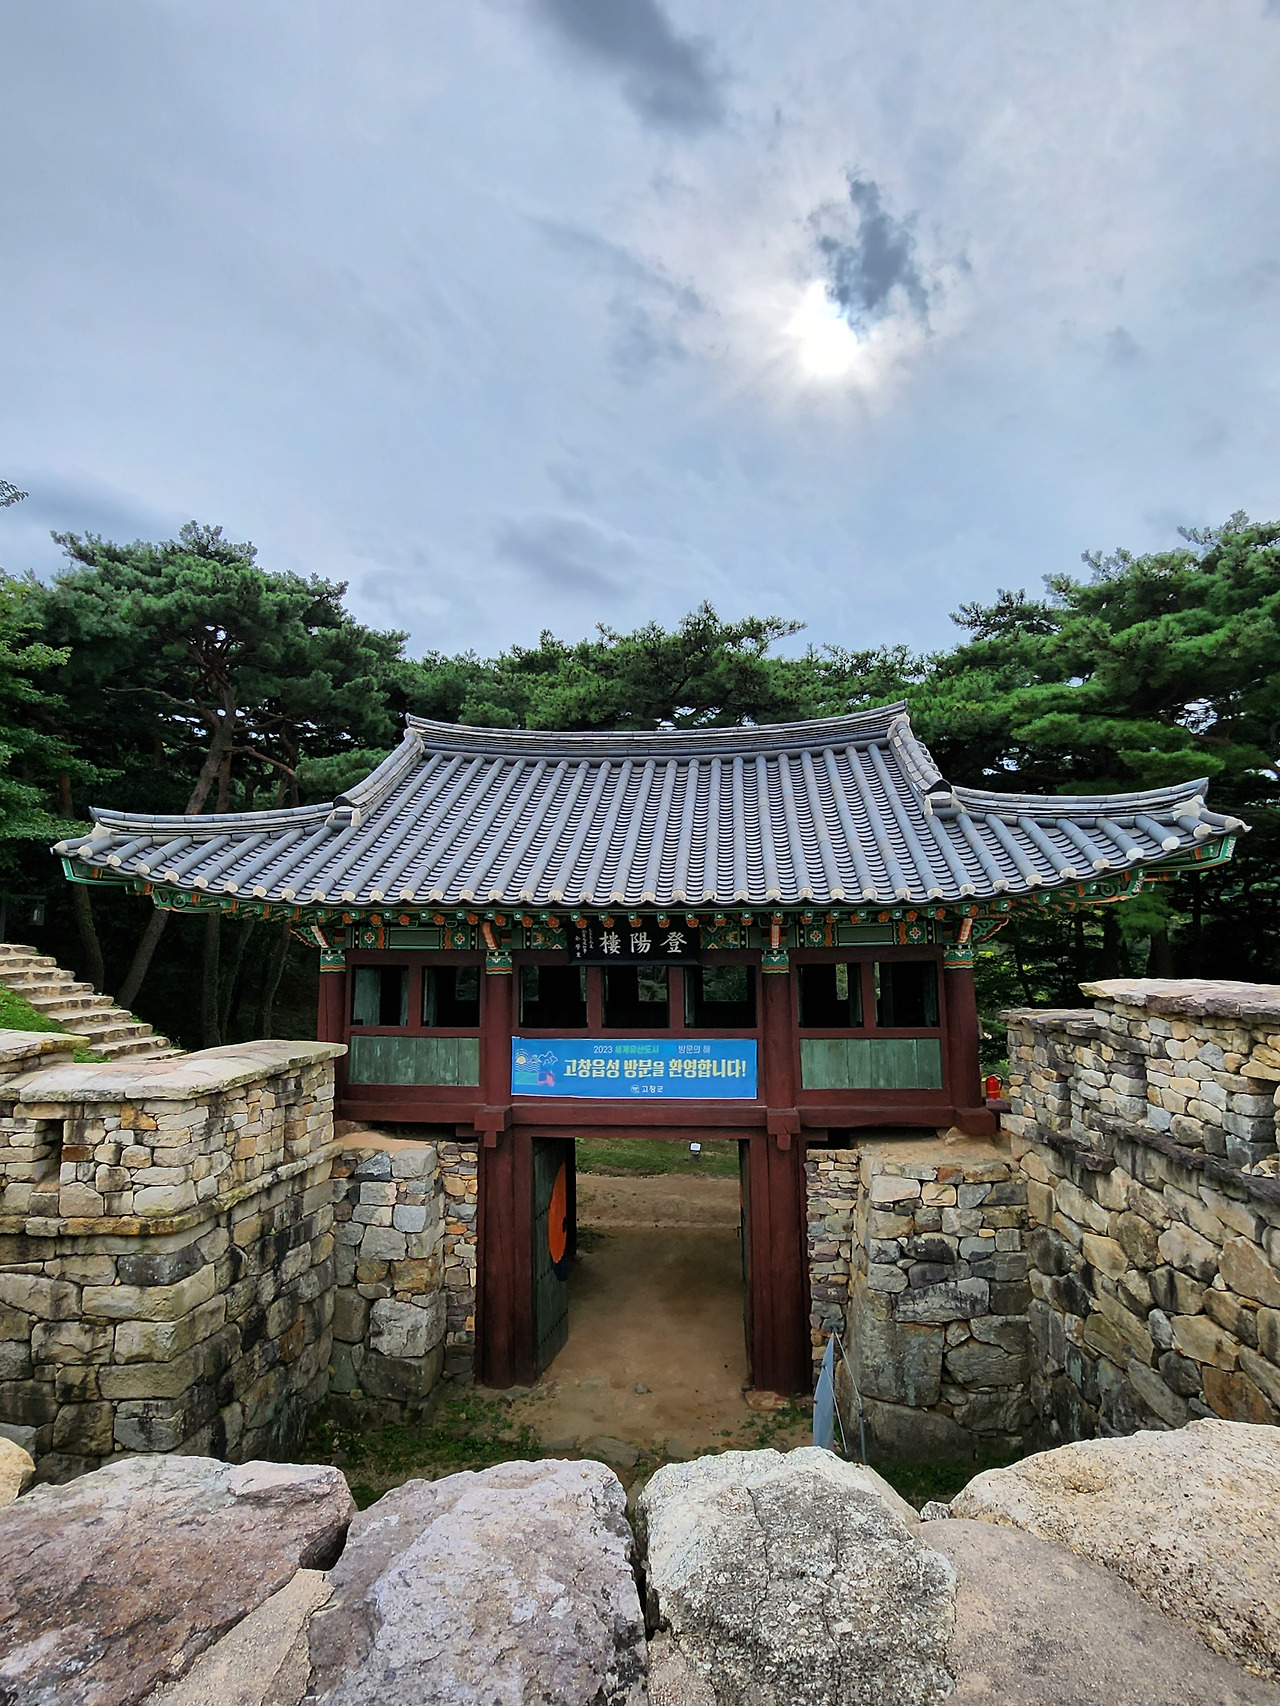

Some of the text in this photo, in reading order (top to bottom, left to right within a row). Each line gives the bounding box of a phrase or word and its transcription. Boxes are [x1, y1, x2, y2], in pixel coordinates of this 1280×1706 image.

[593, 1045, 613, 1054] 2023
[615, 1045, 659, 1054] 세계유산도시
[678, 1045, 701, 1054] 방문의
[703, 1045, 711, 1054] 해
[563, 1058, 747, 1078] 고창읍성 방문을 환영합니다!
